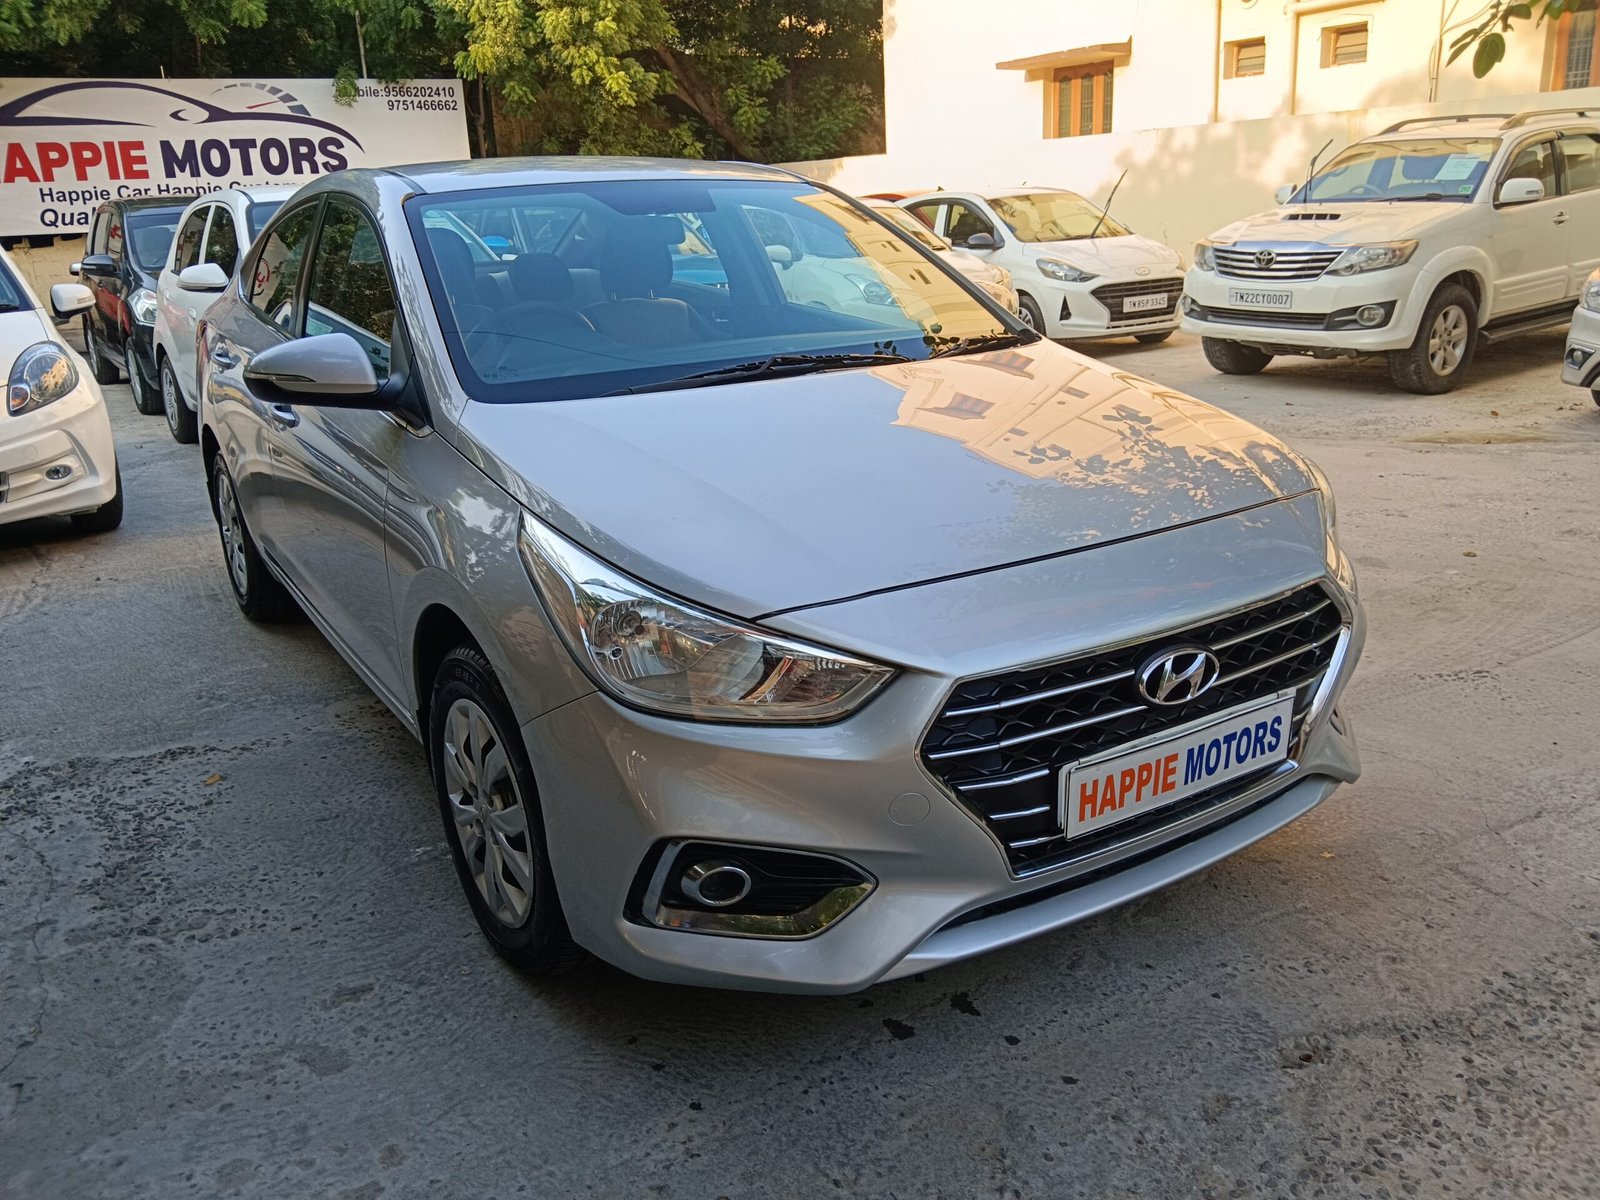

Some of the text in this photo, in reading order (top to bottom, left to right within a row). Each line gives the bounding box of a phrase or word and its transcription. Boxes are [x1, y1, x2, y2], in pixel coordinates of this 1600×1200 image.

[357, 86, 454, 97] bile:9566202410
[387, 100, 458, 111] 9751466662
[0, 137, 348, 183] APPIE MOTORS
[39, 186, 111, 205] Happie
[117, 185, 151, 198] Car
[1234, 291, 1290, 305] TN22CY0007
[1078, 715, 1283, 823] HAPPIE MOTORS
